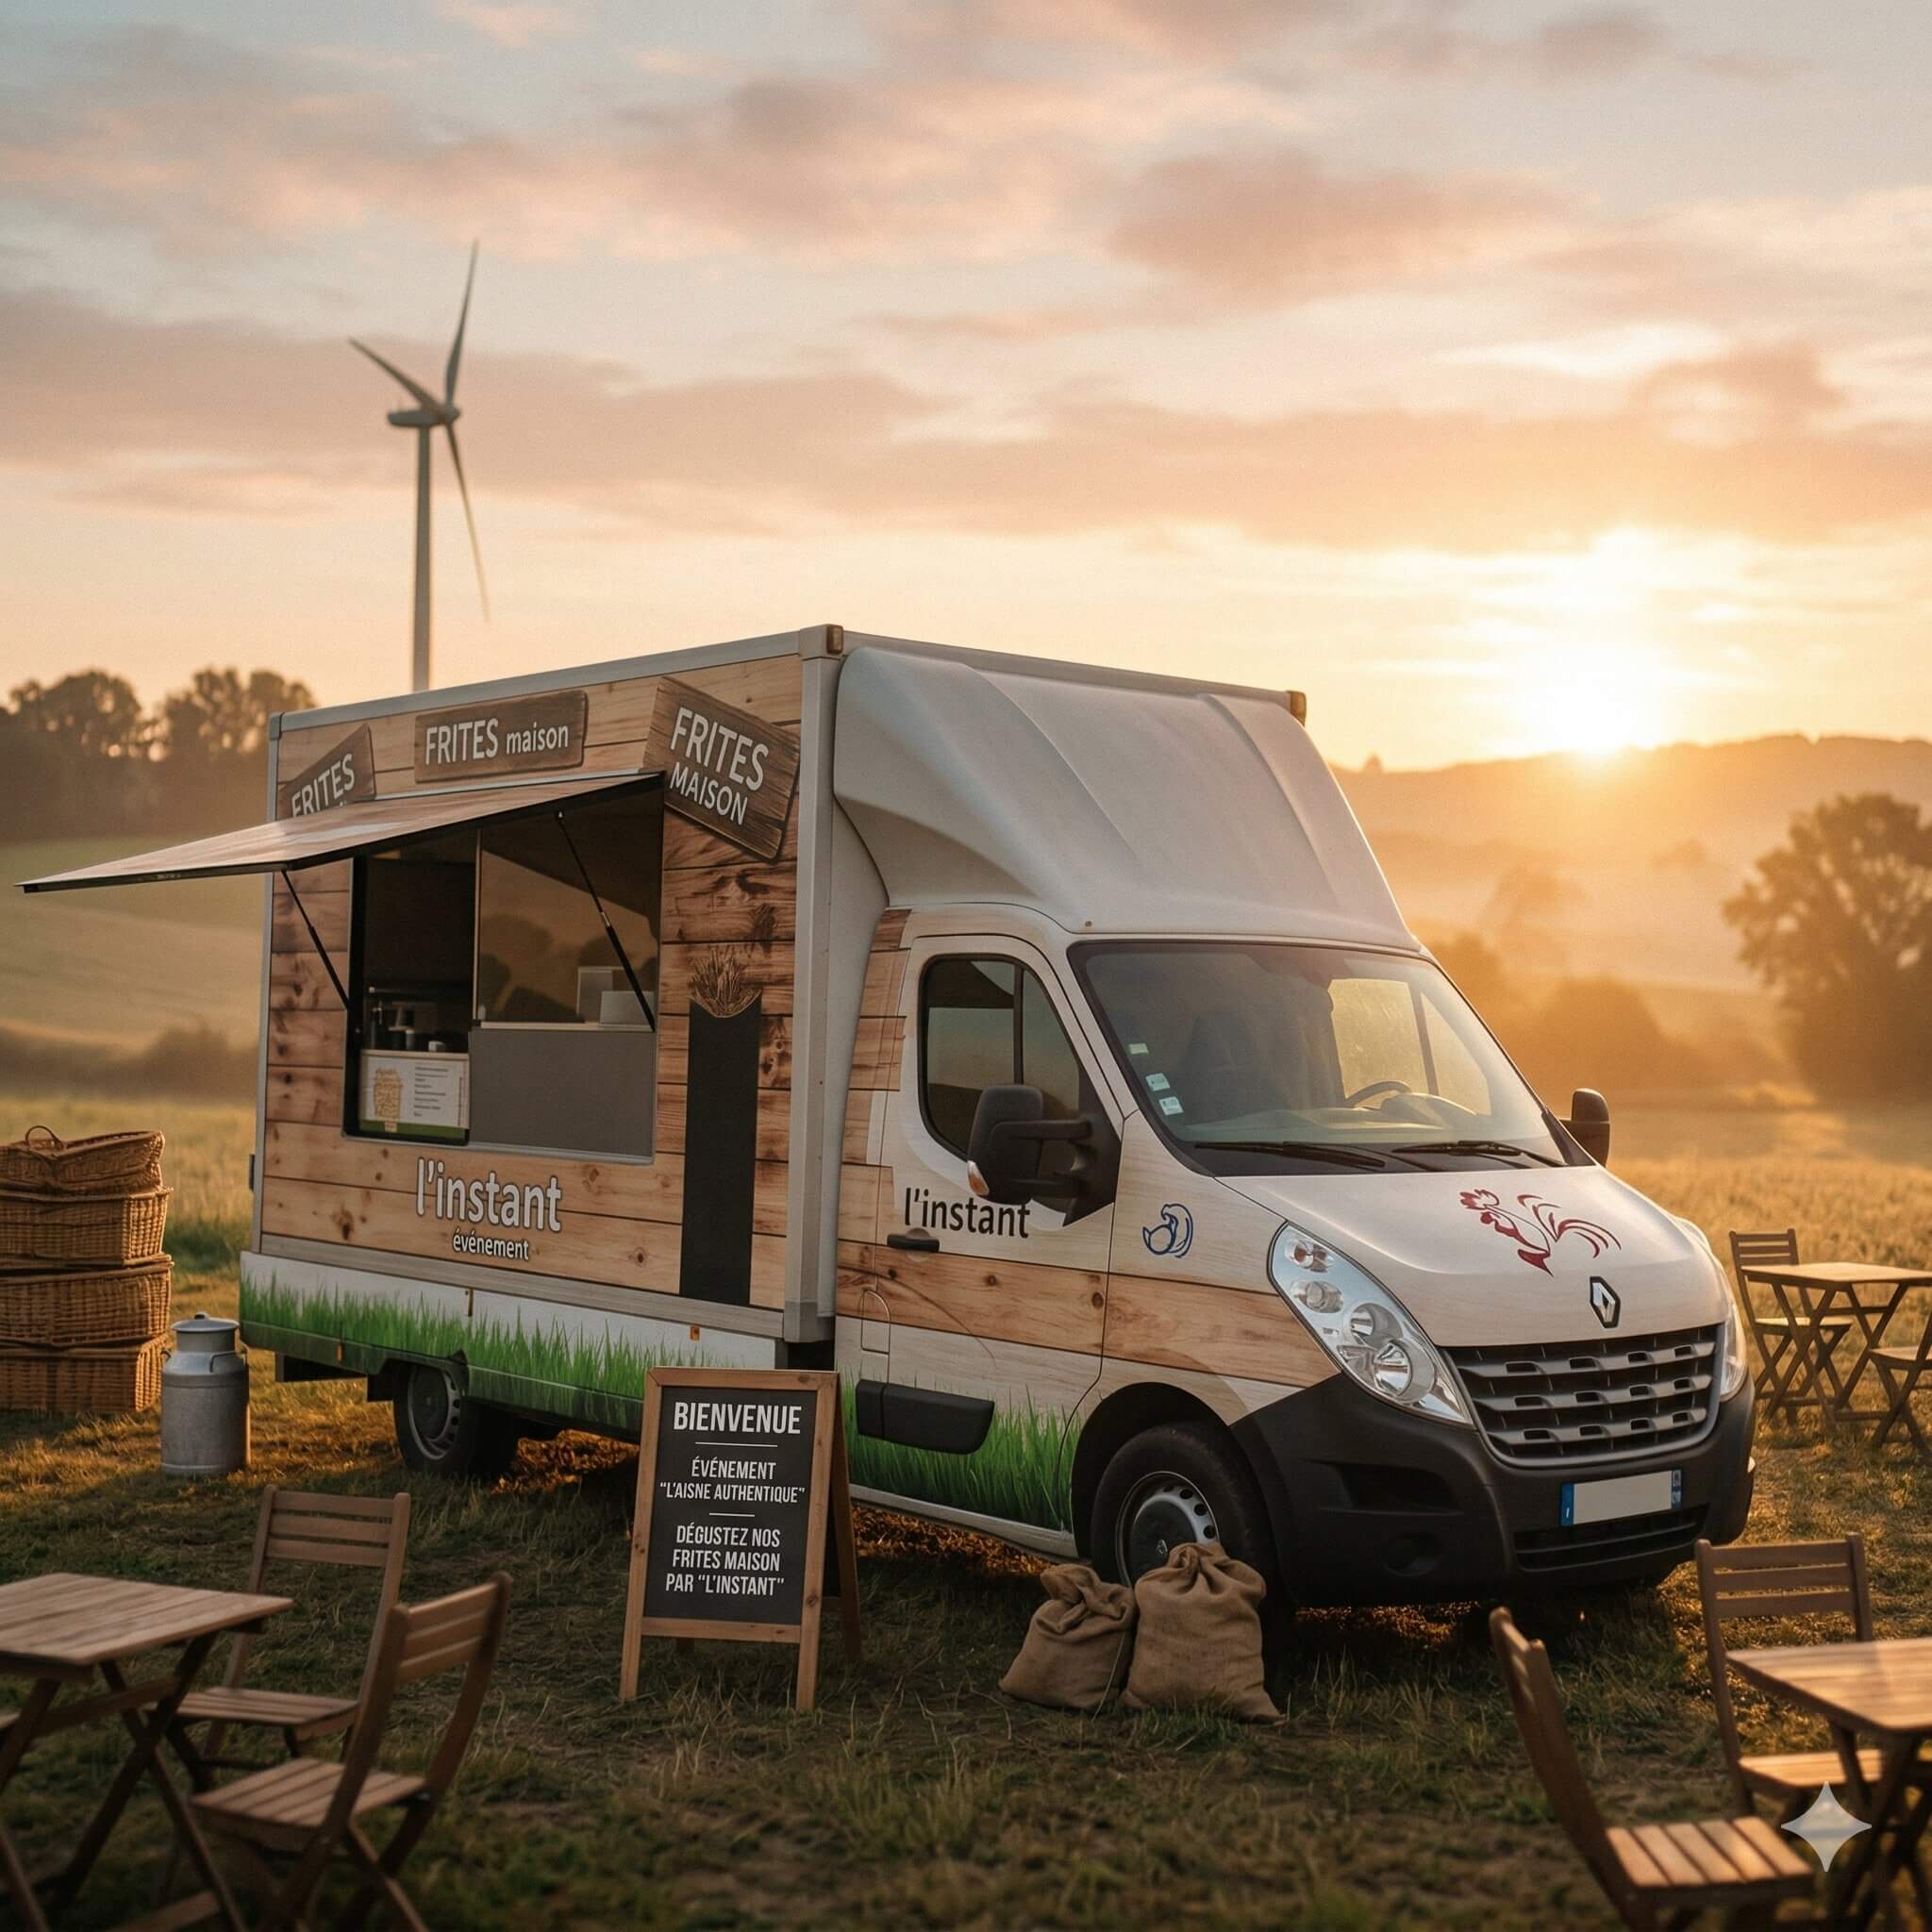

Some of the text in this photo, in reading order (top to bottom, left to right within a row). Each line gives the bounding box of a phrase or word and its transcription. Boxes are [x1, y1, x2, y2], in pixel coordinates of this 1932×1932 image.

[425, 718, 569, 765] FRITES maison
[670, 708, 769, 791] FRITES
[291, 753, 356, 817] FRITES
[670, 762, 748, 825] MAISON
[417, 1158, 561, 1232] l'instant
[905, 1187, 1030, 1239] l'instant
[453, 1229, 529, 1260] événement
[673, 1402, 802, 1435] BIENVENUE
[691, 1456, 776, 1480] ÉVÉNEMENT
[660, 1481, 806, 1504] "L'AISNE AUTHENTIQUE"
[676, 1522, 781, 1547] DÉGUSTEZ NOS
[672, 1548, 781, 1572] FRITES MAISON
[665, 1573, 785, 1596] PAR "L'INSTANT"
